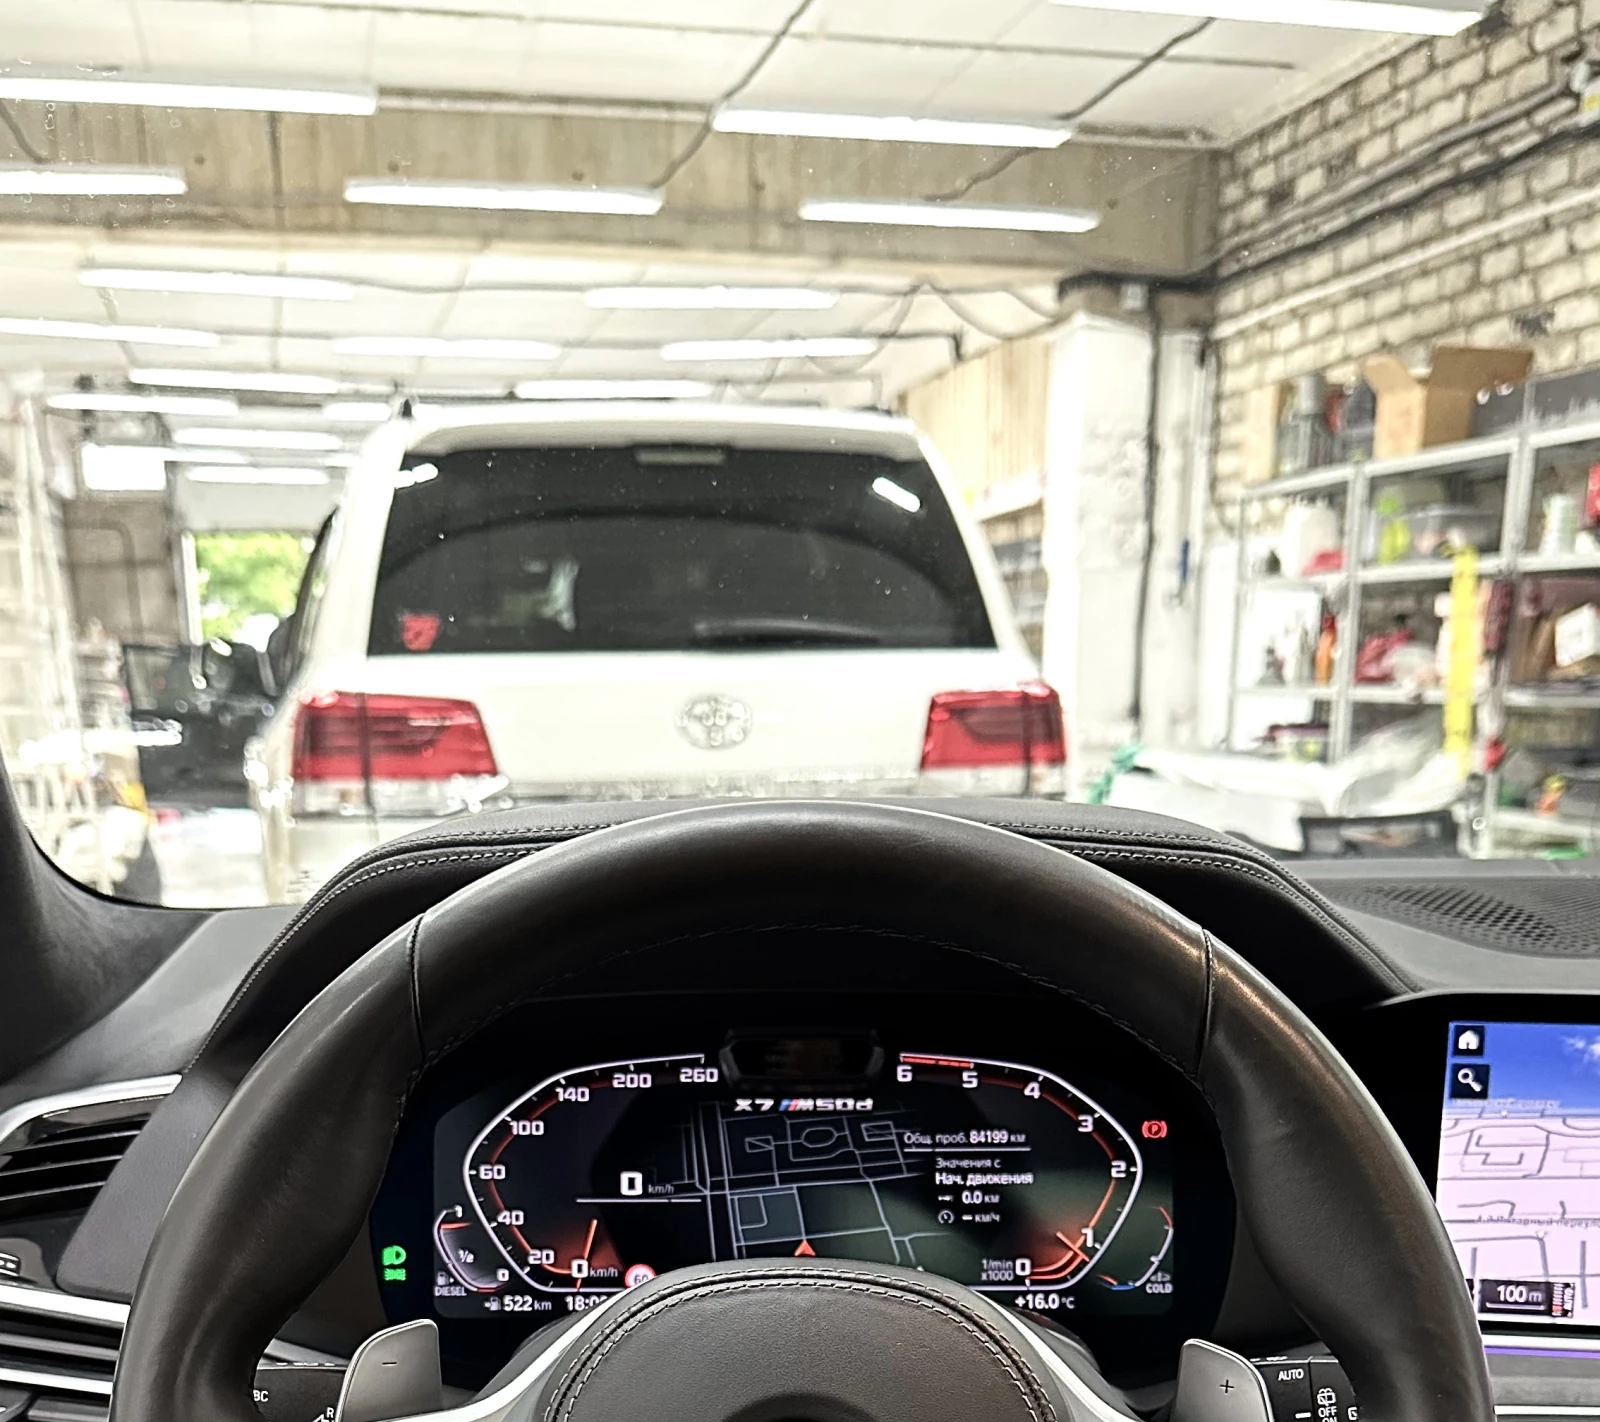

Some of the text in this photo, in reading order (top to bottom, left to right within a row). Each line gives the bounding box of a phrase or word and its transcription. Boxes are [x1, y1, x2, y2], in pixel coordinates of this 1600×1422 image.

[612, 1072, 652, 1089] 200
[680, 1067, 719, 1084] 260
[896, 1065, 913, 1083] 6
[962, 1071, 979, 1089] 5
[556, 1086, 590, 1103] 140
[1024, 1082, 1042, 1099] 4
[734, 1098, 775, 1112] X7
[511, 1120, 545, 1136] 100
[1077, 1115, 1094, 1133] 3
[904, 1131, 1026, 1146] Общ. проб. 84199 км
[935, 1157, 991, 1169] Значения
[1111, 1161, 1127, 1177] 2
[479, 1164, 506, 1180] 60
[935, 1172, 1034, 1187] Нач. движения
[620, 1171, 675, 1196] 0 km/h
[962, 1191, 1000, 1205] 0.0 км
[497, 1210, 525, 1226] 40
[1083, 1227, 1095, 1247] 1
[528, 1249, 555, 1265] 20
[981, 1259, 1014, 1271] 1/min
[496, 1268, 508, 1282] 0
[571, 1259, 619, 1279] 0 km/h
[981, 1270, 1014, 1282] x1000
[1015, 1259, 1031, 1277] 0
[434, 1285, 467, 1298] DIESEL
[1146, 1282, 1173, 1294] COLD
[1496, 1284, 1542, 1303] 100 m
[503, 1295, 553, 1312] 522 km
[1014, 1294, 1060, 1311] +16.0
[1278, 1368, 1304, 1381] AUTO
[1318, 1406, 1338, 1418] OFF
